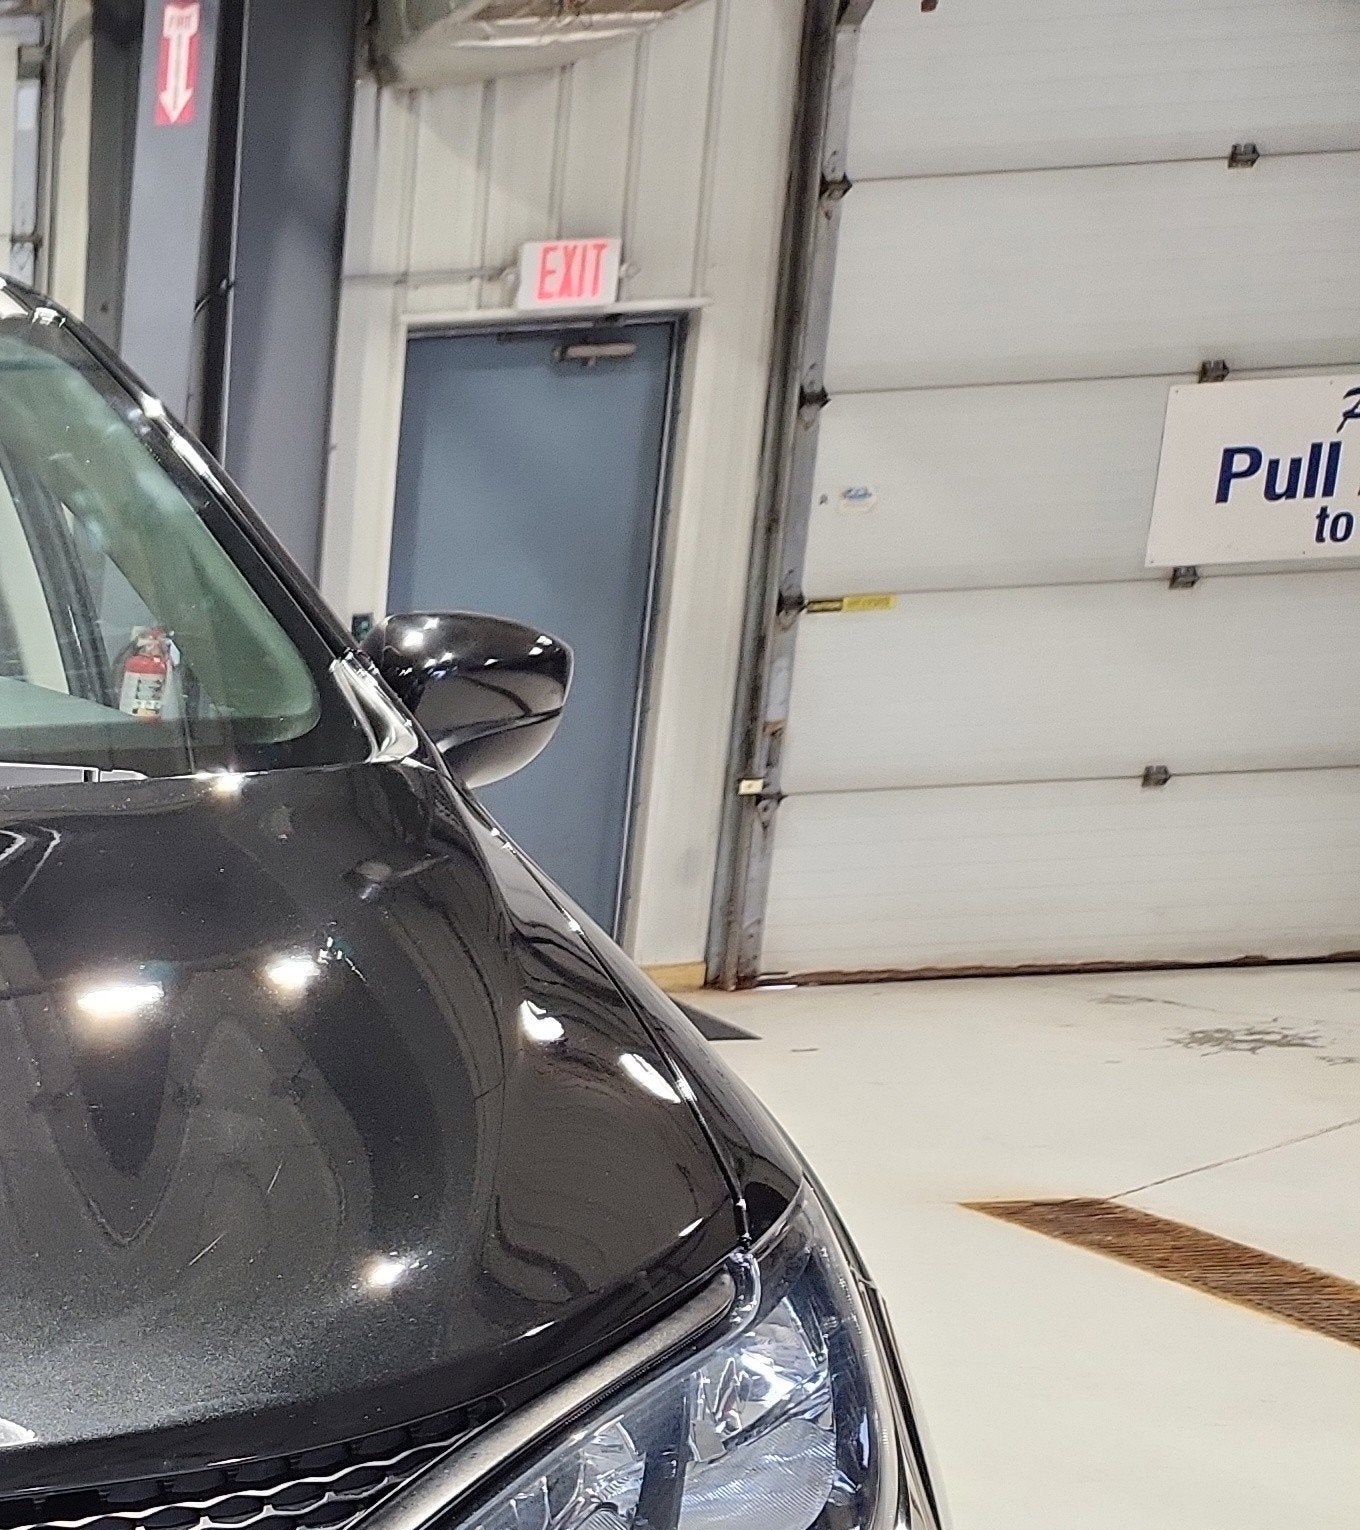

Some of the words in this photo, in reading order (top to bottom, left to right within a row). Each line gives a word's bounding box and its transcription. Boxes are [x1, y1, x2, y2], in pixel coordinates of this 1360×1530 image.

[536, 243, 608, 299] EXIT
[1215, 441, 1342, 504] Pull
[1315, 506, 1354, 543] to
